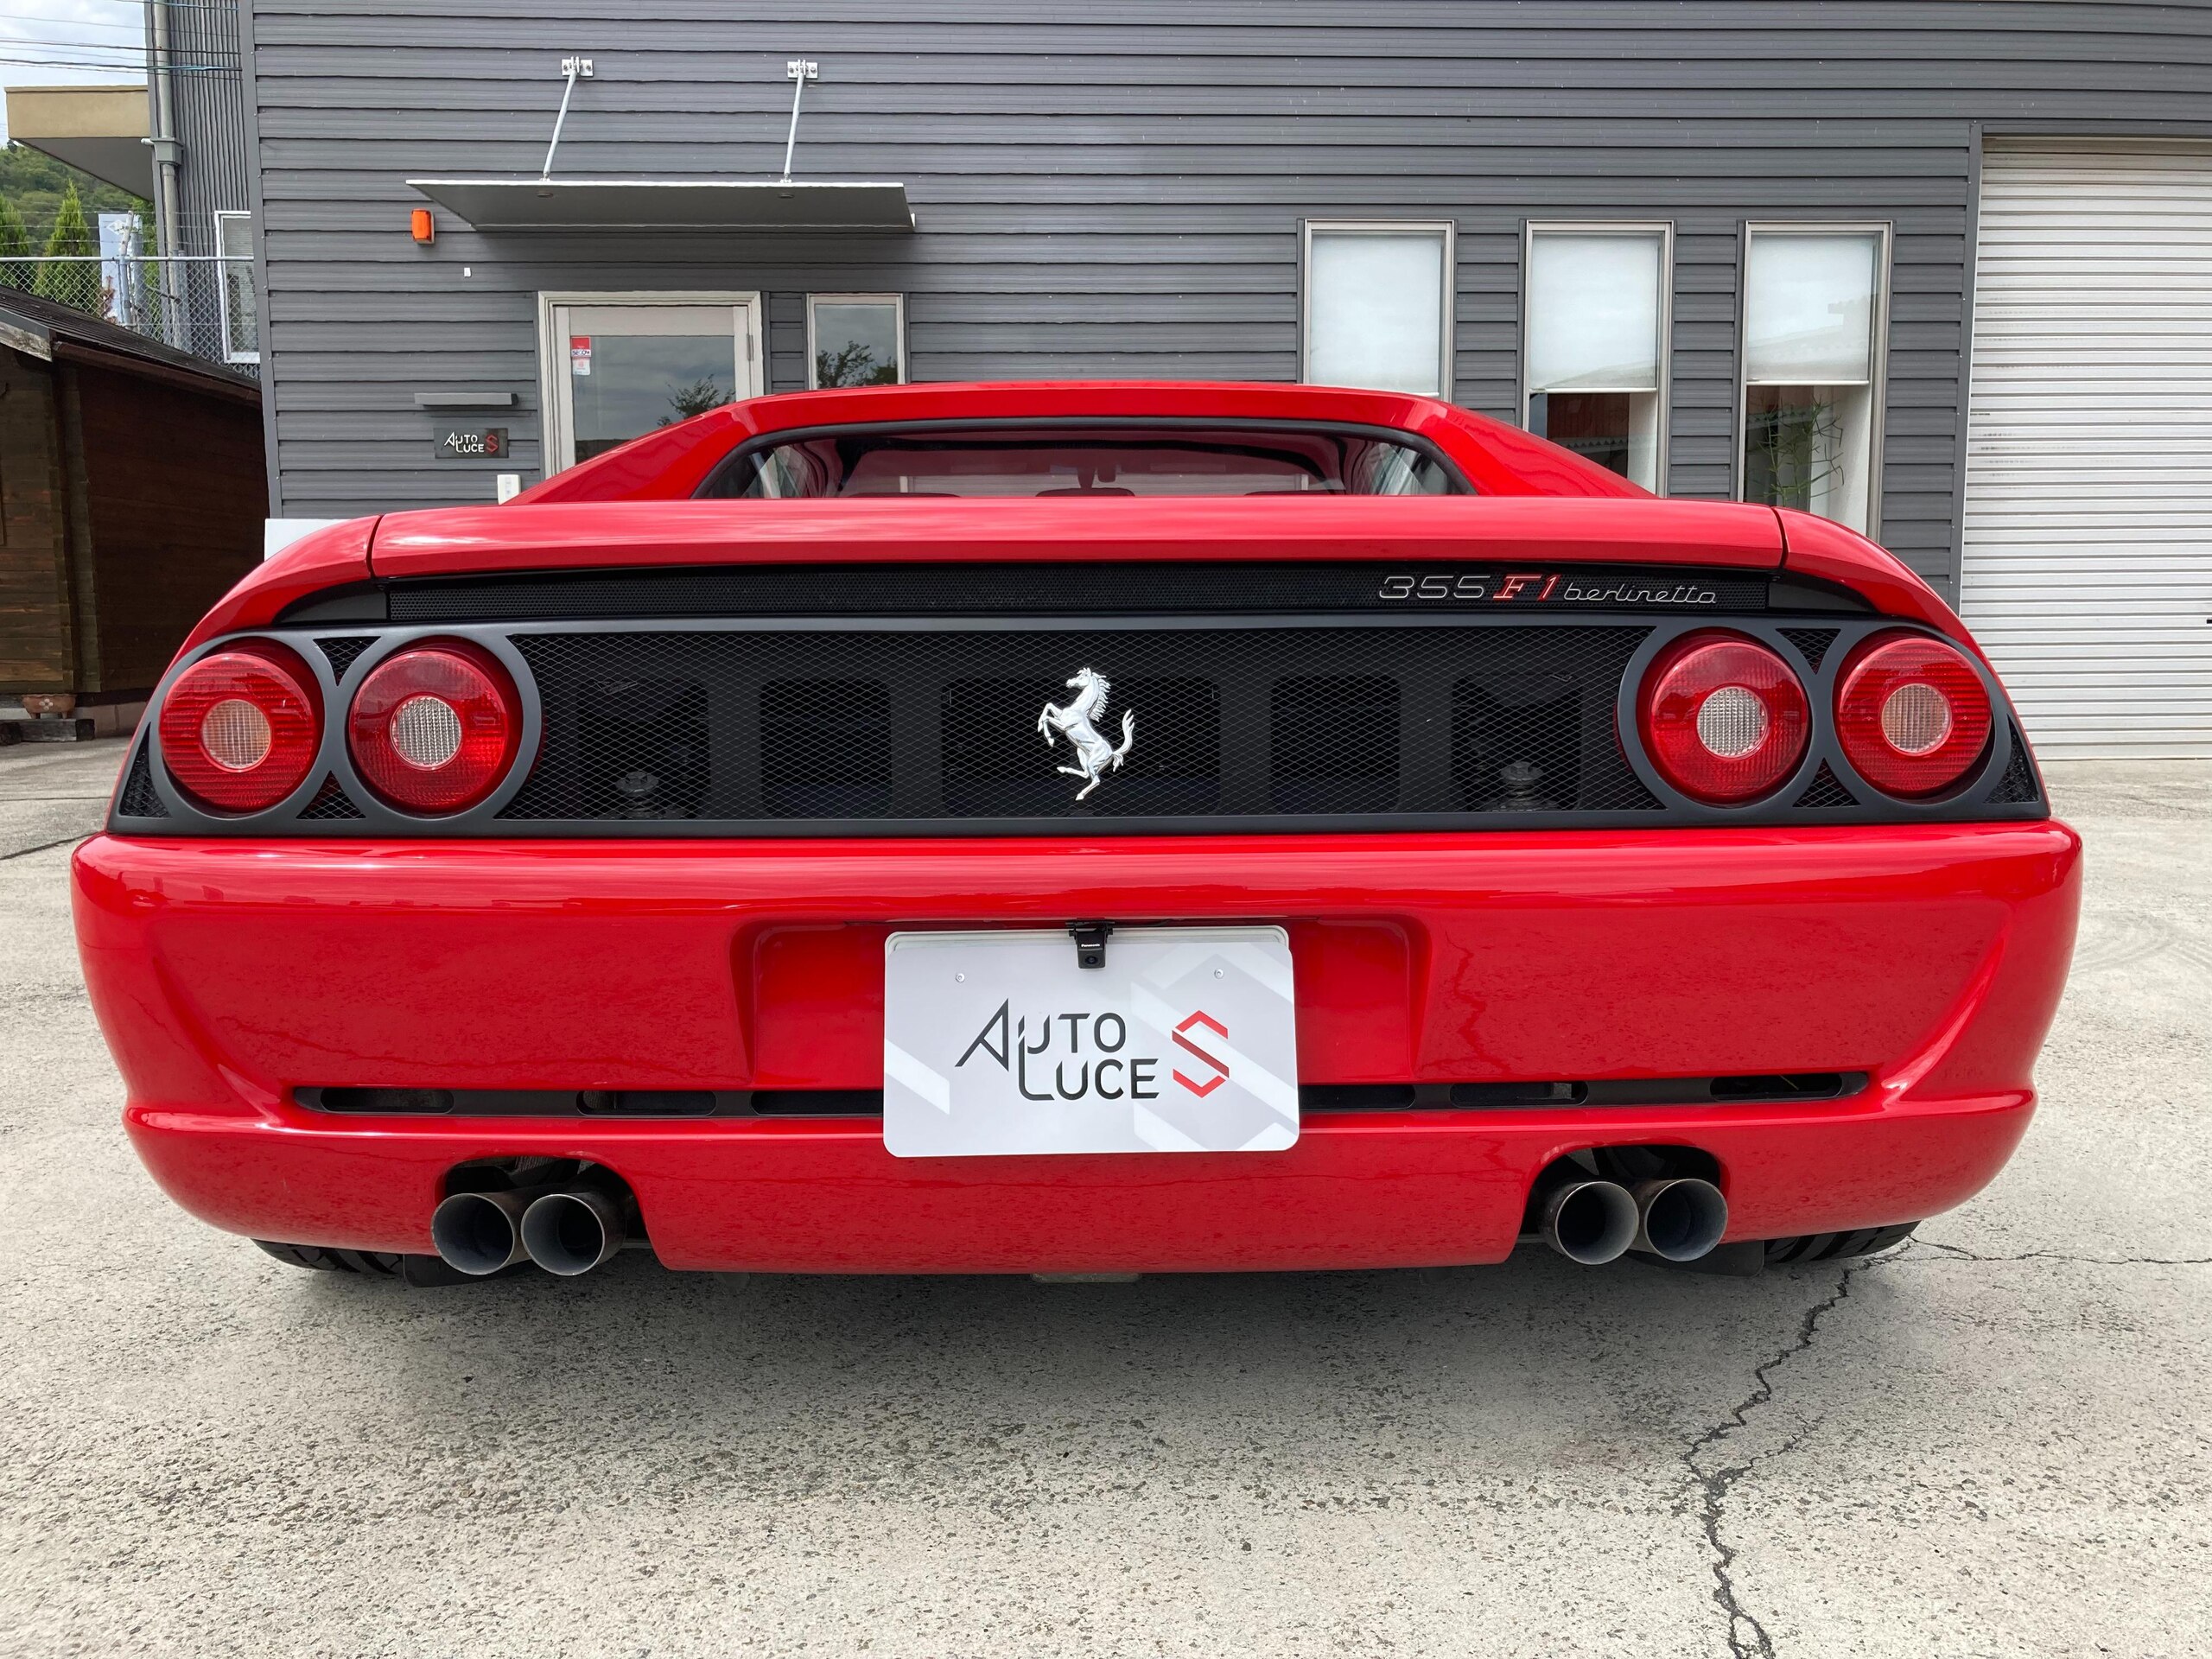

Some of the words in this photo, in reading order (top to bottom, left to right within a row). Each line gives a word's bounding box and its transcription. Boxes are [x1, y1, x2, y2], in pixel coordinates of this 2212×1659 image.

[443, 431, 479, 447] AUTO
[455, 439, 485, 453] LUCE
[486, 434, 499, 453] S
[1379, 575, 1491, 600] 355
[1492, 573, 1562, 601] F1
[1563, 582, 1717, 605] berlinetta
[954, 997, 1127, 1072] AUTO
[1017, 1035, 1160, 1102] LUCE
[1171, 1009, 1230, 1099] S
